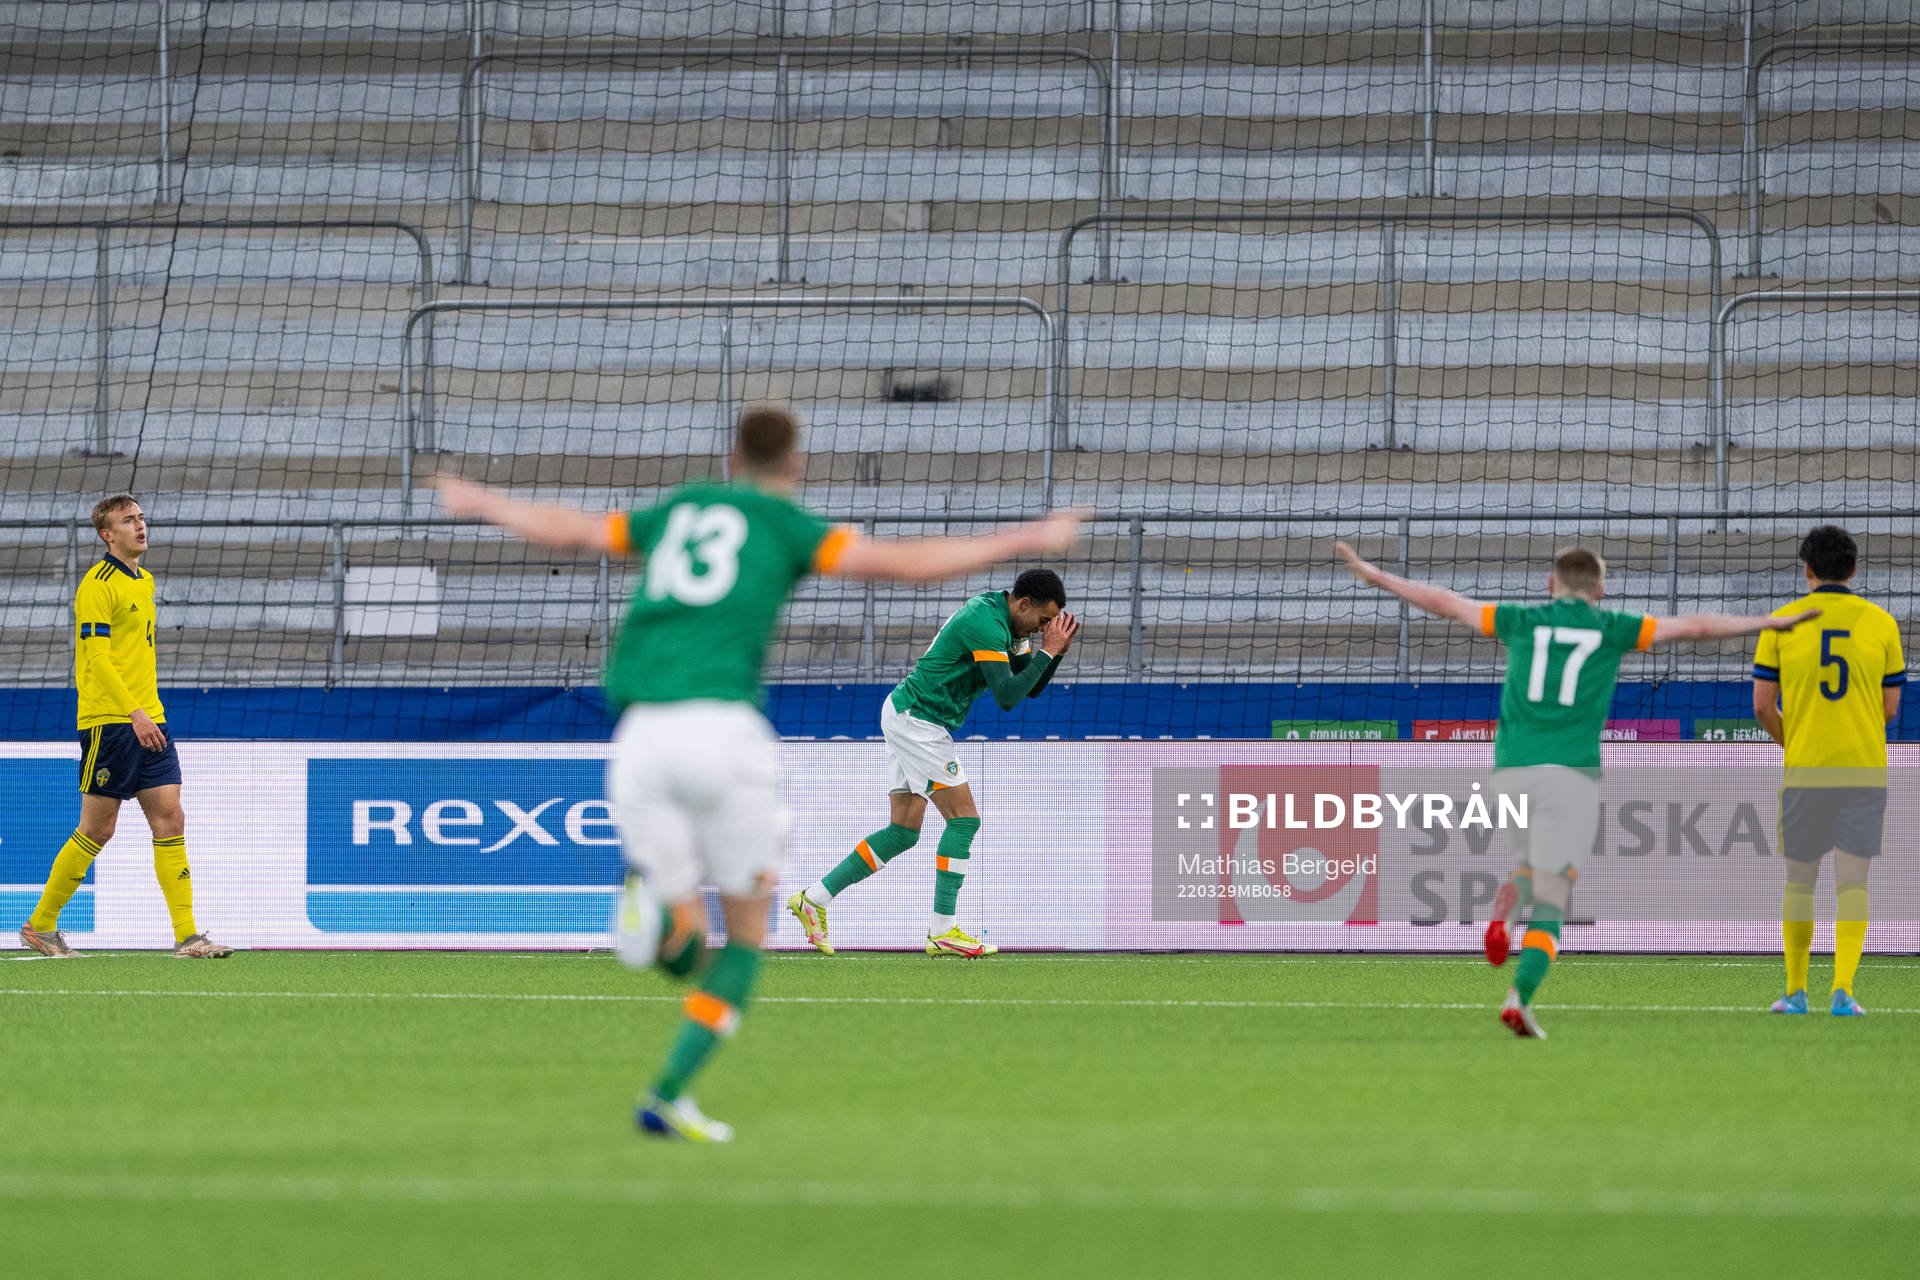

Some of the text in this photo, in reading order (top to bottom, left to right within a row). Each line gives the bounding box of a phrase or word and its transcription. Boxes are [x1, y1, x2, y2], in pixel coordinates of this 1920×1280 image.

[647, 502, 749, 606] 13
[1527, 625, 1603, 707] 17
[1819, 629, 1851, 702] 5
[1600, 728, 1638, 740] INSKAD
[352, 797, 624, 853] Rexe
[1410, 800, 1772, 856] SVSKA
[1410, 870, 1596, 926] SPL
